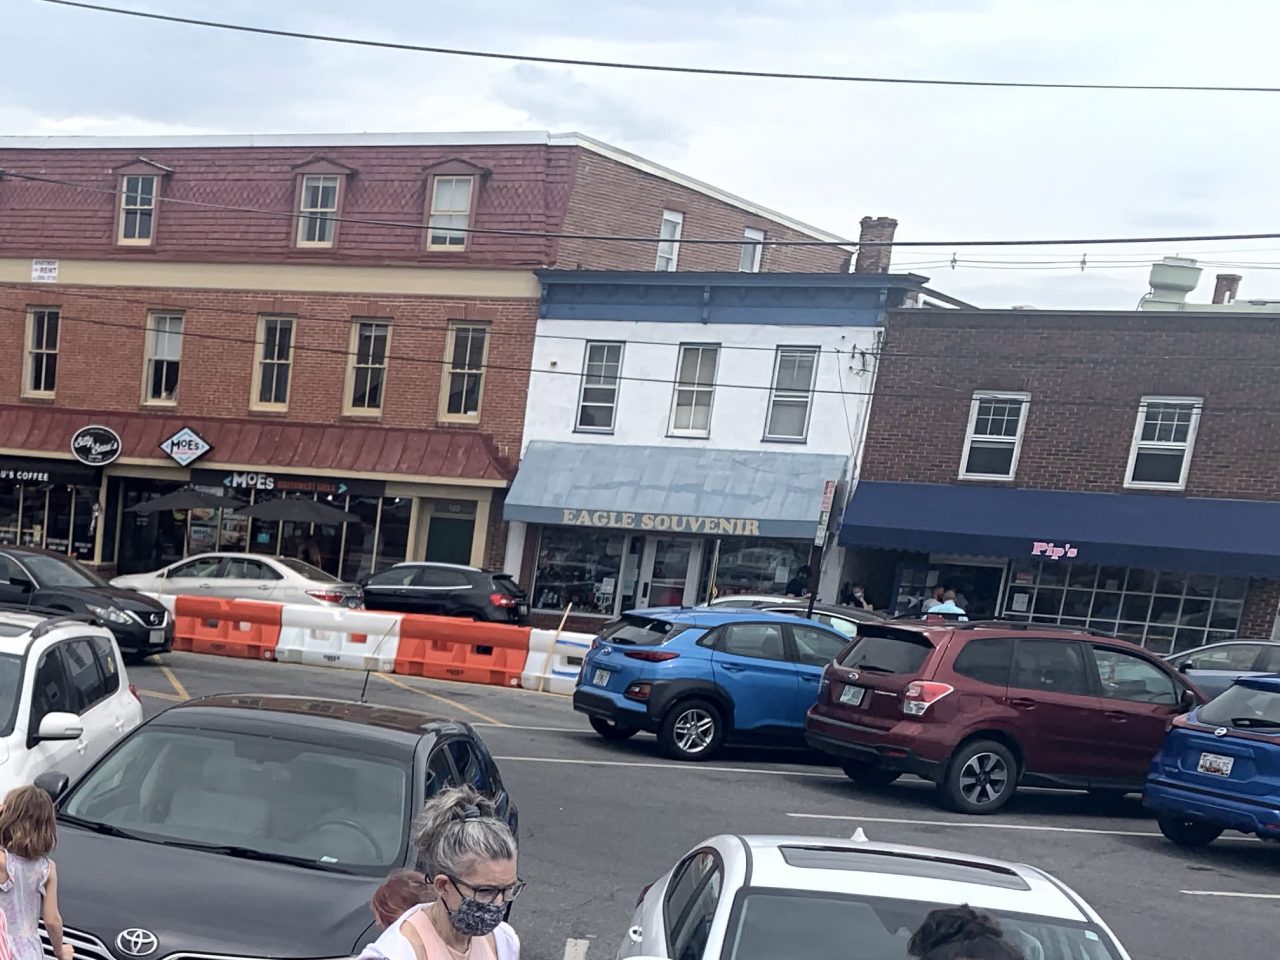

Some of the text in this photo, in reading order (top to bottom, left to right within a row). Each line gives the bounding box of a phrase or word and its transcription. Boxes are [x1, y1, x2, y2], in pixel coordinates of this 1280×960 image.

[16, 471, 49, 481] COFFEE
[562, 509, 761, 536] EAGLE SOUVENIR
[1031, 541, 1078, 560] Pip's
